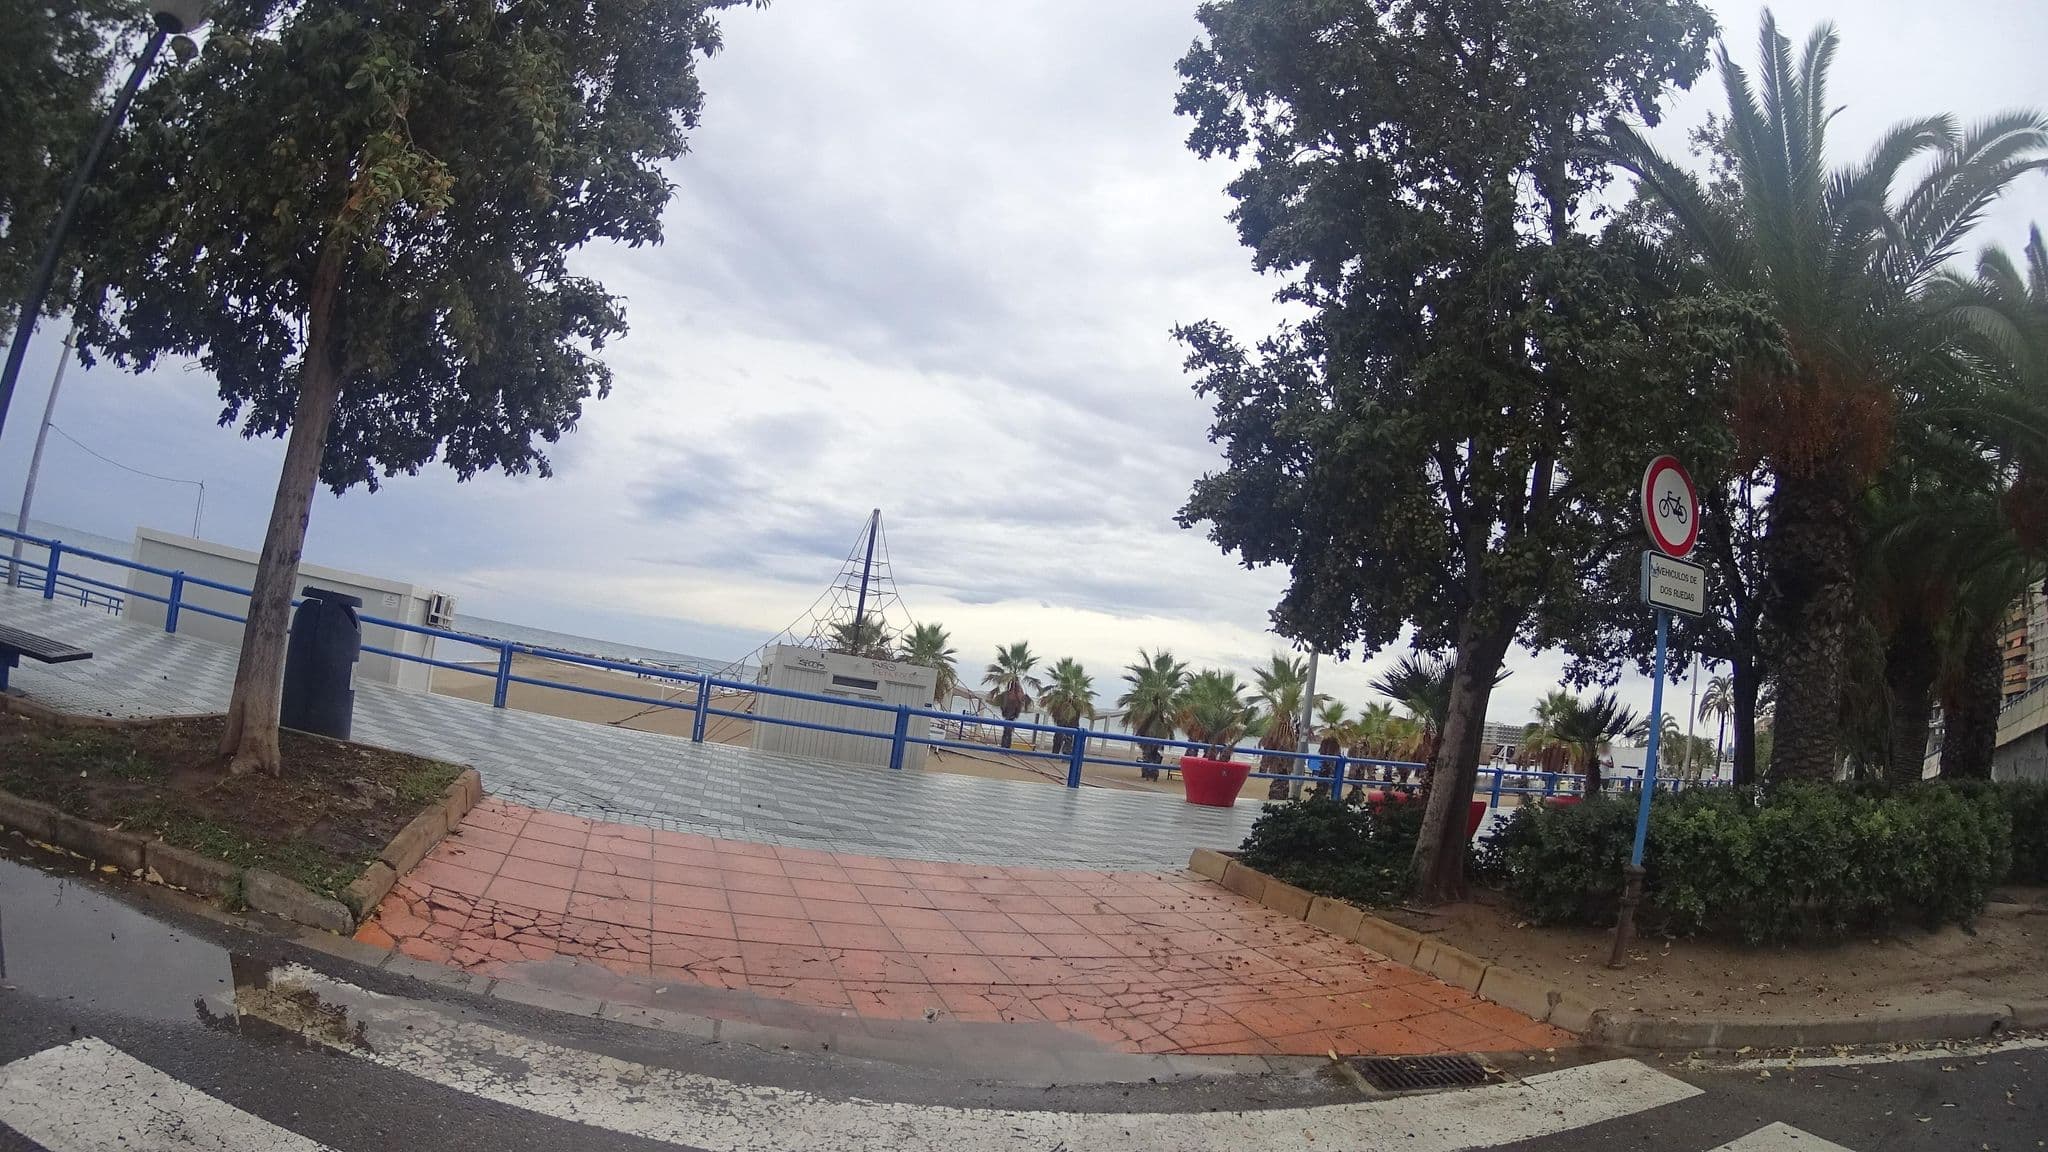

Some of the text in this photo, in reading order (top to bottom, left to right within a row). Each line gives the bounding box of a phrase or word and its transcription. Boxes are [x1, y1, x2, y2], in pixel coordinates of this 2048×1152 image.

[1690, 575, 1697, 584] DE
[1660, 585, 1695, 602] DOS RUEDAS
